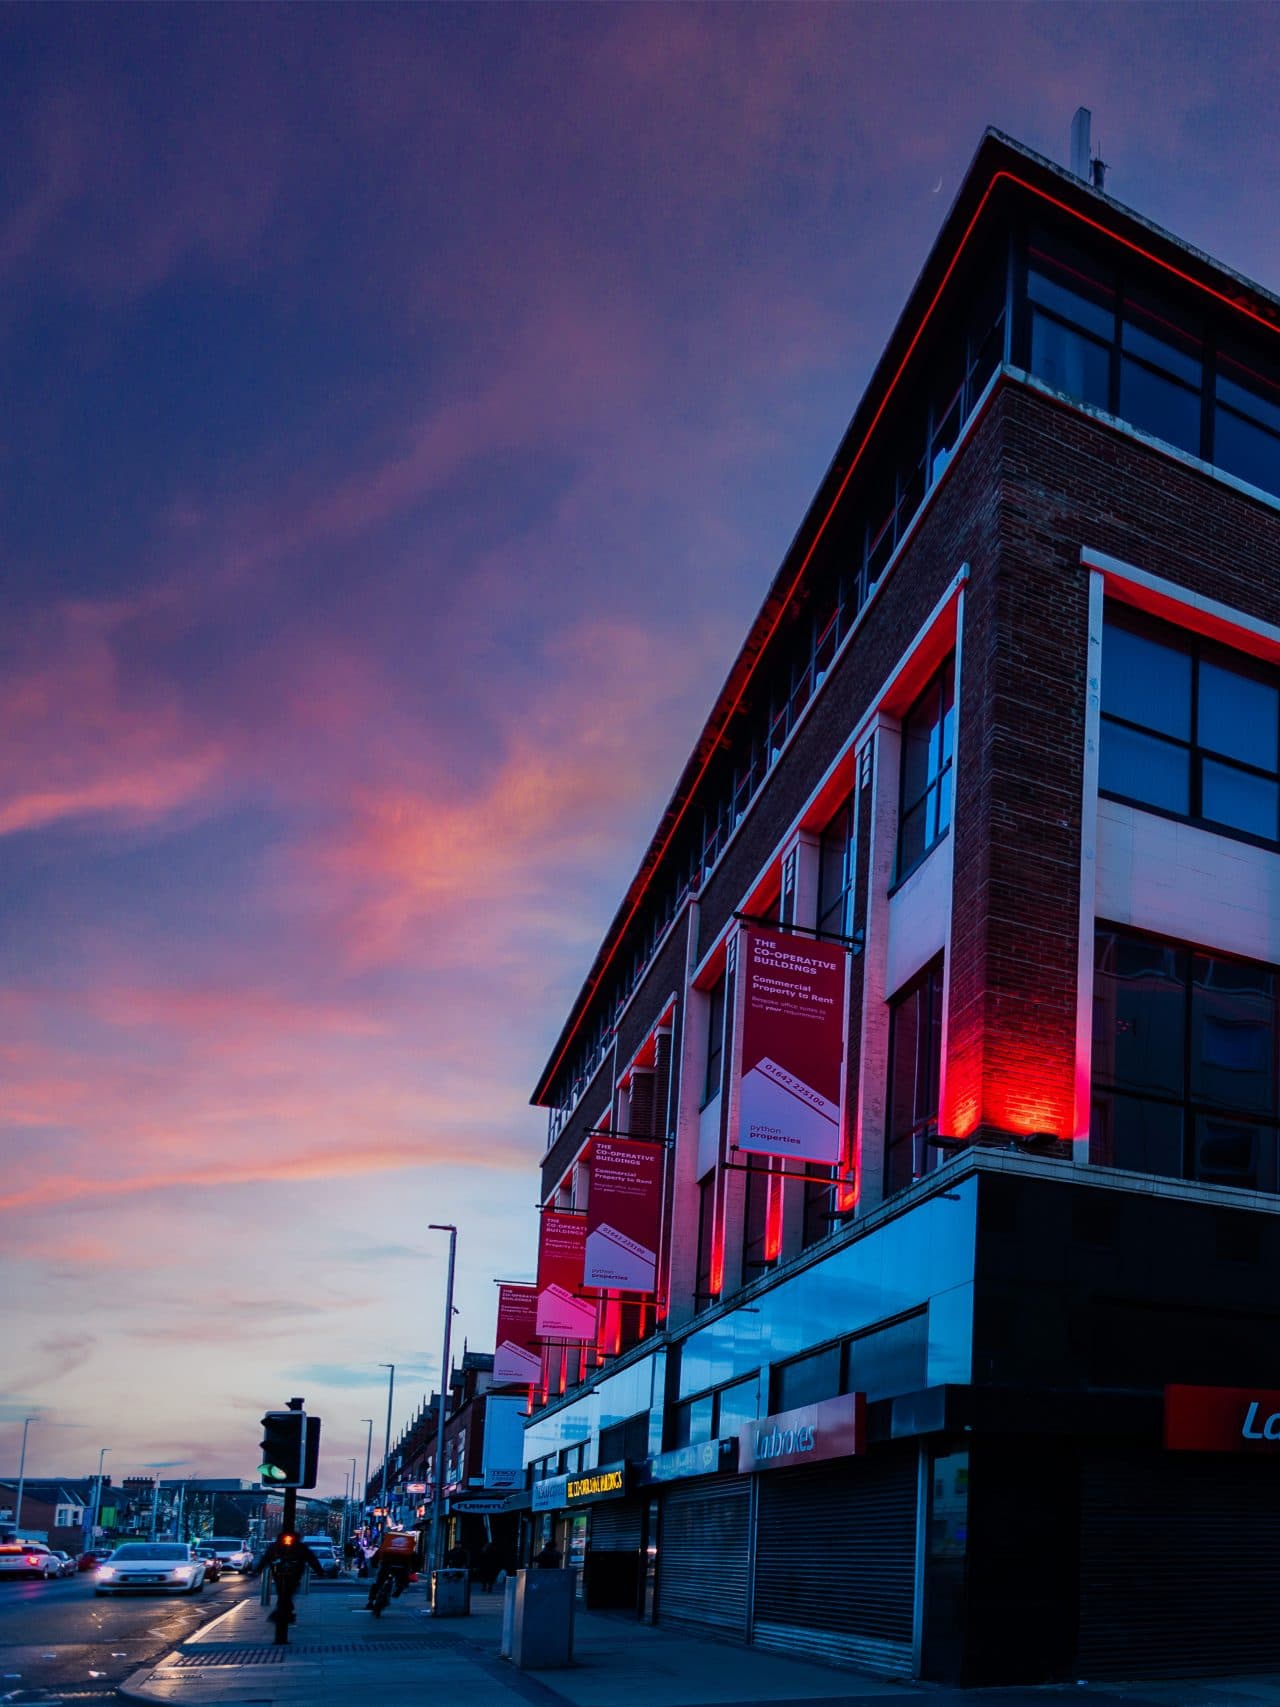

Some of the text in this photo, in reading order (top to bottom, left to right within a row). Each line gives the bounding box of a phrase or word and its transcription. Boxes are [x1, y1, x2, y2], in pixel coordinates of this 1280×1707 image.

[754, 938, 776, 949] THE
[753, 956, 817, 975] BUILDINGS
[754, 947, 837, 970] CO-OPERATIVE
[752, 975, 811, 992] Commercial
[752, 982, 834, 1004] Property to Rent
[764, 1064, 825, 1107] 01642 225100
[750, 1124, 782, 1135] python
[750, 1132, 801, 1145] properties
[595, 1155, 641, 1166] BUILDINGS
[596, 1149, 655, 1162] CO-OPERATIVE
[755, 1420, 816, 1461] Ladbrokes
